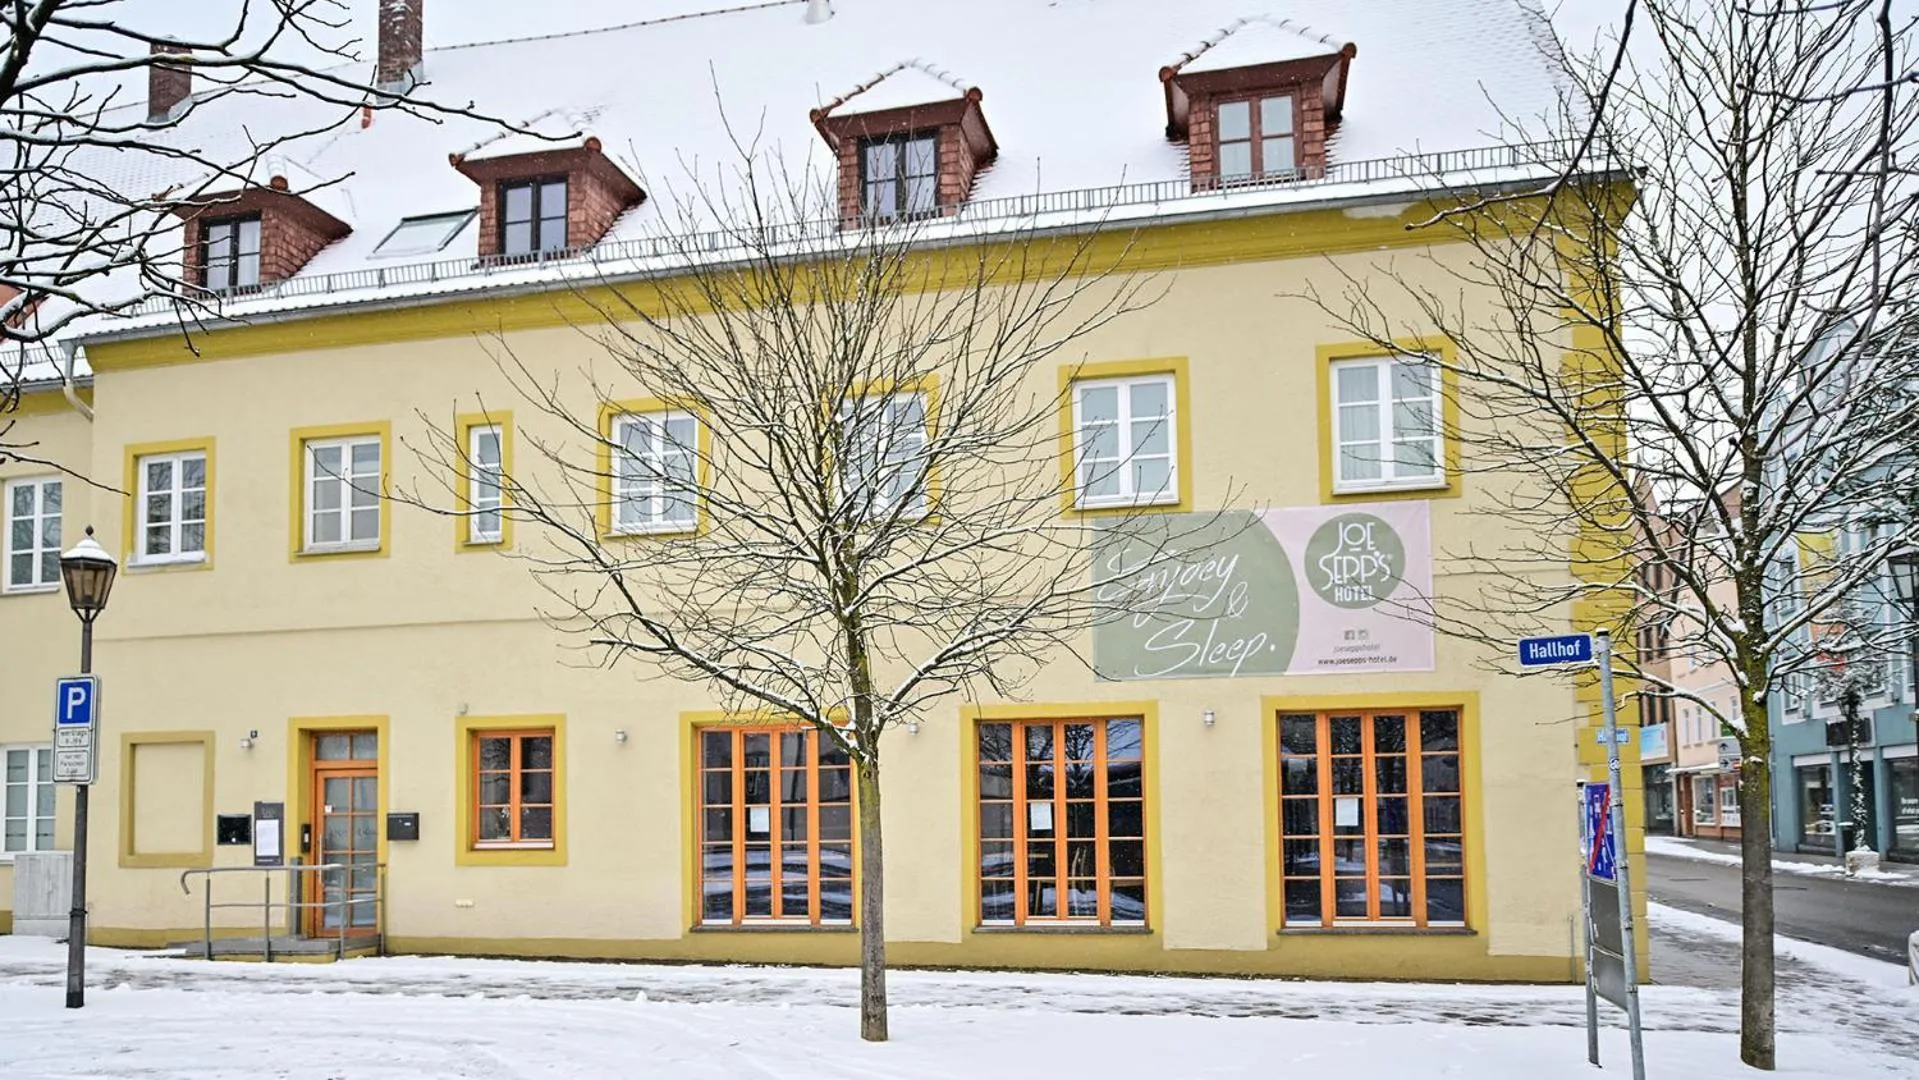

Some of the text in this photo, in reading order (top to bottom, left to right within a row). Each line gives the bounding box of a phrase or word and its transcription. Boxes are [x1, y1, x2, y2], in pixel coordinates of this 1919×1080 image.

[1335, 521, 1377, 553] JOE
[1228, 581, 1249, 618] &
[1334, 585, 1376, 602] HOTEL
[1133, 618, 1276, 677] Sleep.
[1528, 640, 1581, 659] Hallhof
[67, 686, 86, 720] P
